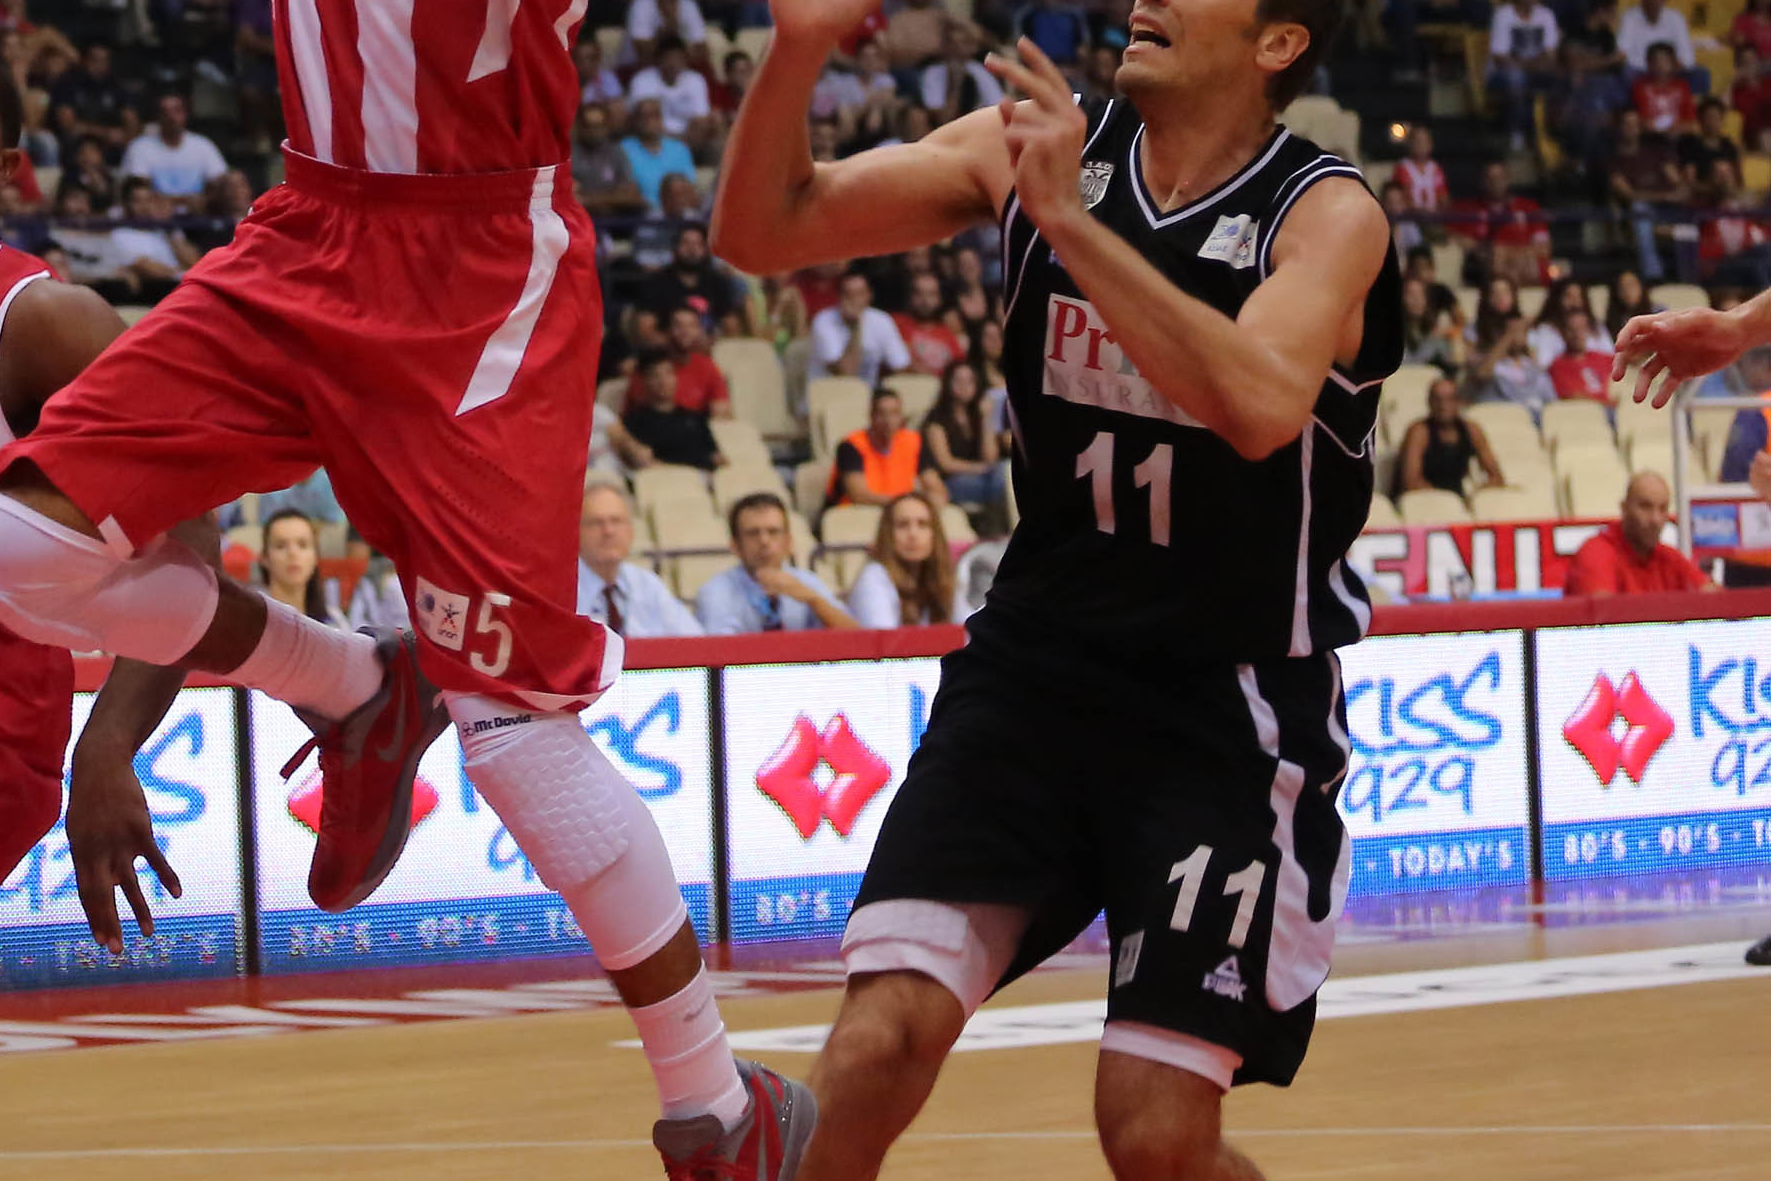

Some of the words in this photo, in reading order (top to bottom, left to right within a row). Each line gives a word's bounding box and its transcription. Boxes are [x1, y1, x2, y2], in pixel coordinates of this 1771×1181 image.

[1075, 431, 1174, 547] 11
[470, 592, 513, 677] 5
[1166, 843, 1266, 950] 11
[1388, 840, 1513, 879] TODAY'S
